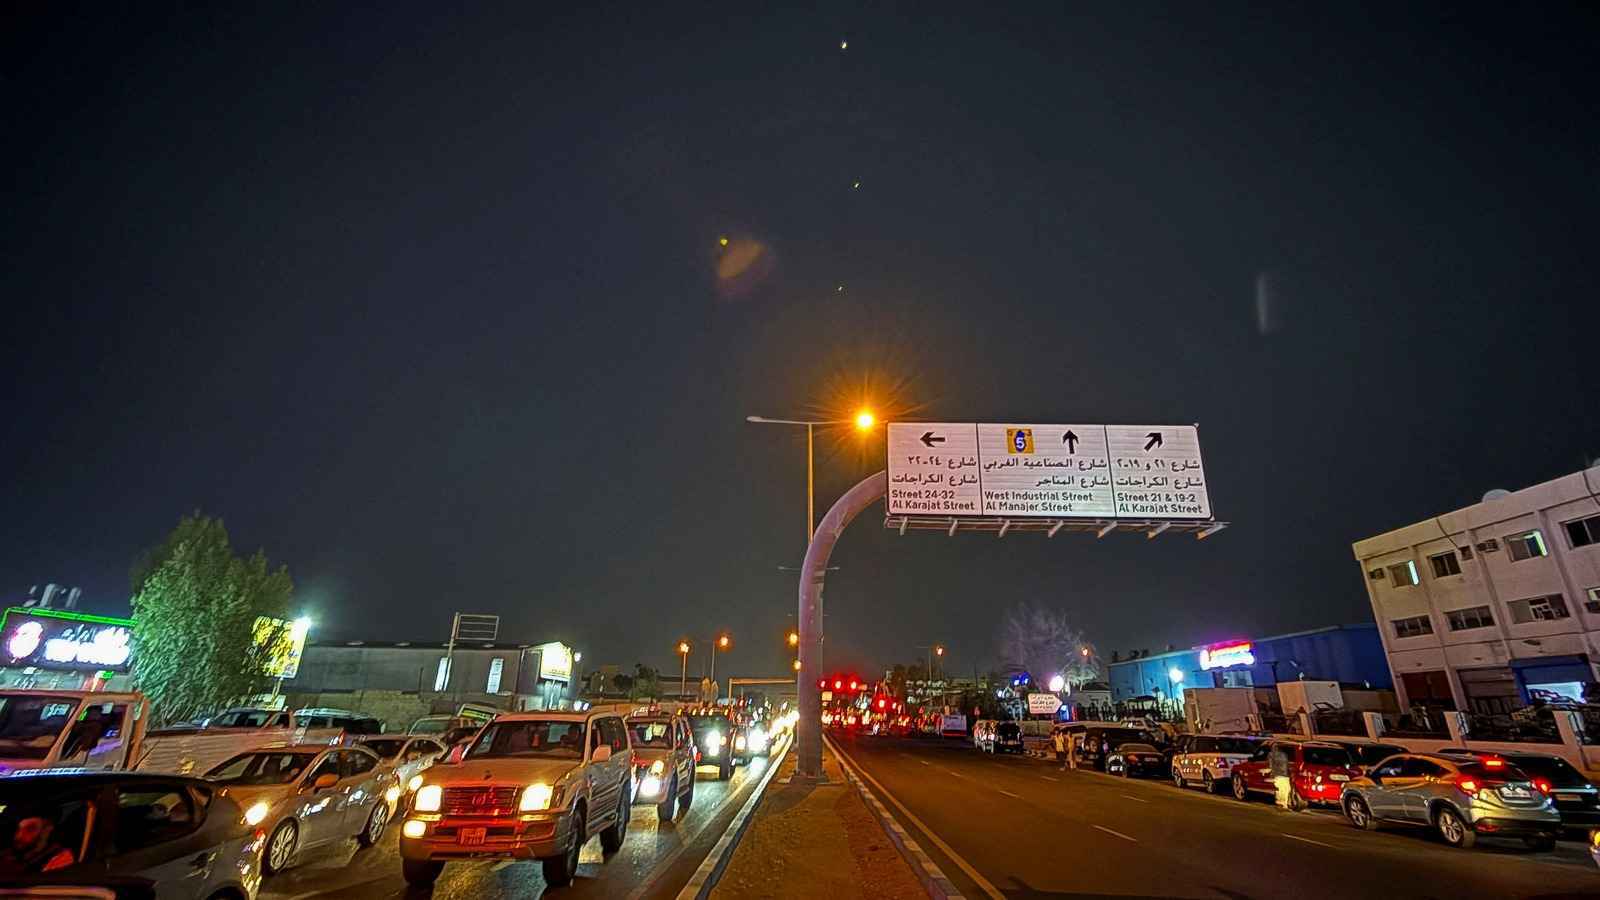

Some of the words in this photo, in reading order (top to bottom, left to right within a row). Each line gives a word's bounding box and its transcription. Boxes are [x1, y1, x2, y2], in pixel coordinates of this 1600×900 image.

[1016, 437, 1025, 449] 5
[948, 456, 977, 469] شارع
[1023, 458, 1073, 470] الصناعية
[1078, 459, 1107, 471] شارع
[1171, 460, 1200, 472] شارع
[891, 473, 943, 486] الكراجات
[949, 474, 978, 487] شارع
[1080, 475, 1109, 488] شارع
[1116, 476, 1168, 488] الكراجات
[1174, 477, 1203, 489] شارع
[892, 489, 922, 499] Street
[925, 490, 955, 499] 24-32
[985, 491, 1009, 500] West
[1012, 491, 1059, 501] Industrial
[1062, 492, 1093, 501] Street
[1117, 493, 1148, 502] Street
[1150, 493, 1161, 502] 21
[1165, 493, 1172, 502] &
[1175, 494, 1196, 502] 19-2
[892, 500, 903, 509] Al
[905, 500, 941, 510] Karajat
[943, 501, 975, 510] Street
[985, 502, 996, 511] Al
[999, 502, 1038, 512] Manajer
[1041, 503, 1073, 512] Street
[1119, 503, 1129, 513] Al
[1132, 503, 1168, 514] Karajat
[1171, 504, 1202, 514] Street
